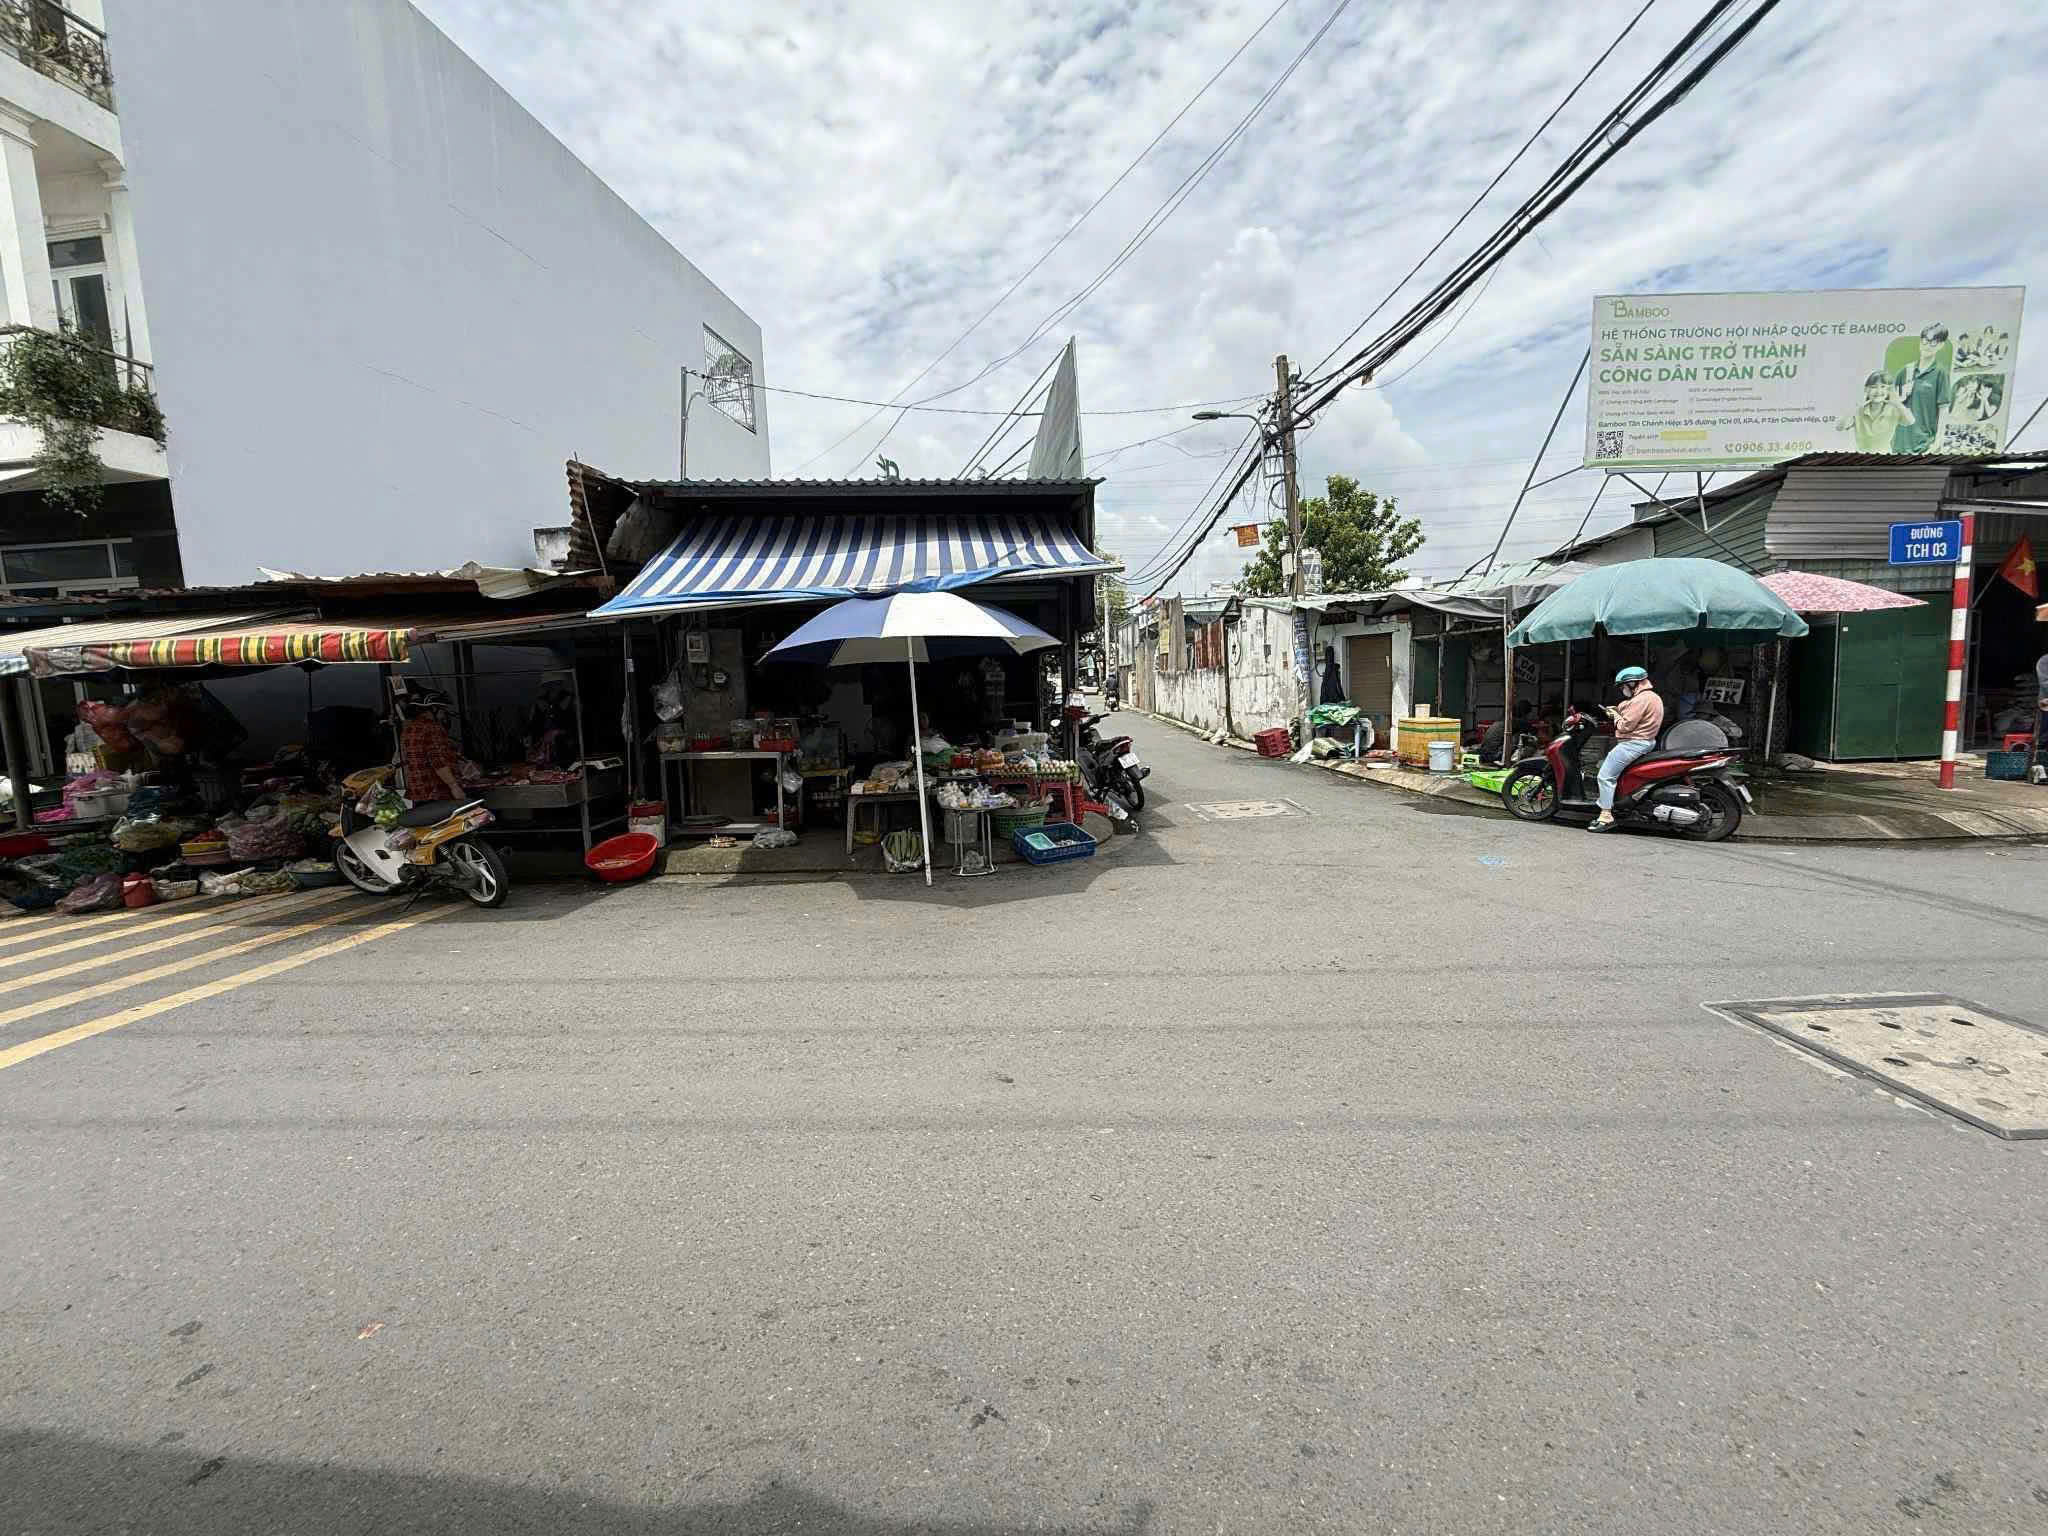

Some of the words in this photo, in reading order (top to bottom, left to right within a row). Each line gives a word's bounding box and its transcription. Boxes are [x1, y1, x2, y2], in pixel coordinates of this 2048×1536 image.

[1601, 328, 1618, 340] HỆ
[1622, 326, 1667, 339] THỐNG
[1670, 325, 1722, 338] TRƯỜNG
[1726, 325, 1748, 338] HỘI
[1752, 323, 1787, 336] NHẬP
[1791, 321, 1829, 336] QUỐC
[1831, 321, 1846, 334] TẾ
[1849, 323, 1906, 334] BAMBOO
[1600, 342, 1638, 361] SẴN
[1643, 344, 1694, 360] SÀNG
[1700, 341, 1737, 360] TRỞ
[1743, 341, 1807, 359] THÀNH
[1600, 365, 1652, 383] CÔNG
[1658, 364, 1698, 381] DÂN
[1703, 363, 1754, 380] TOÀN
[1759, 360, 1798, 379] CẦU
[1911, 526, 1943, 539] ĐƯỜNG
[1905, 543, 1929, 558] TCH
[1932, 542, 1947, 557] 03
